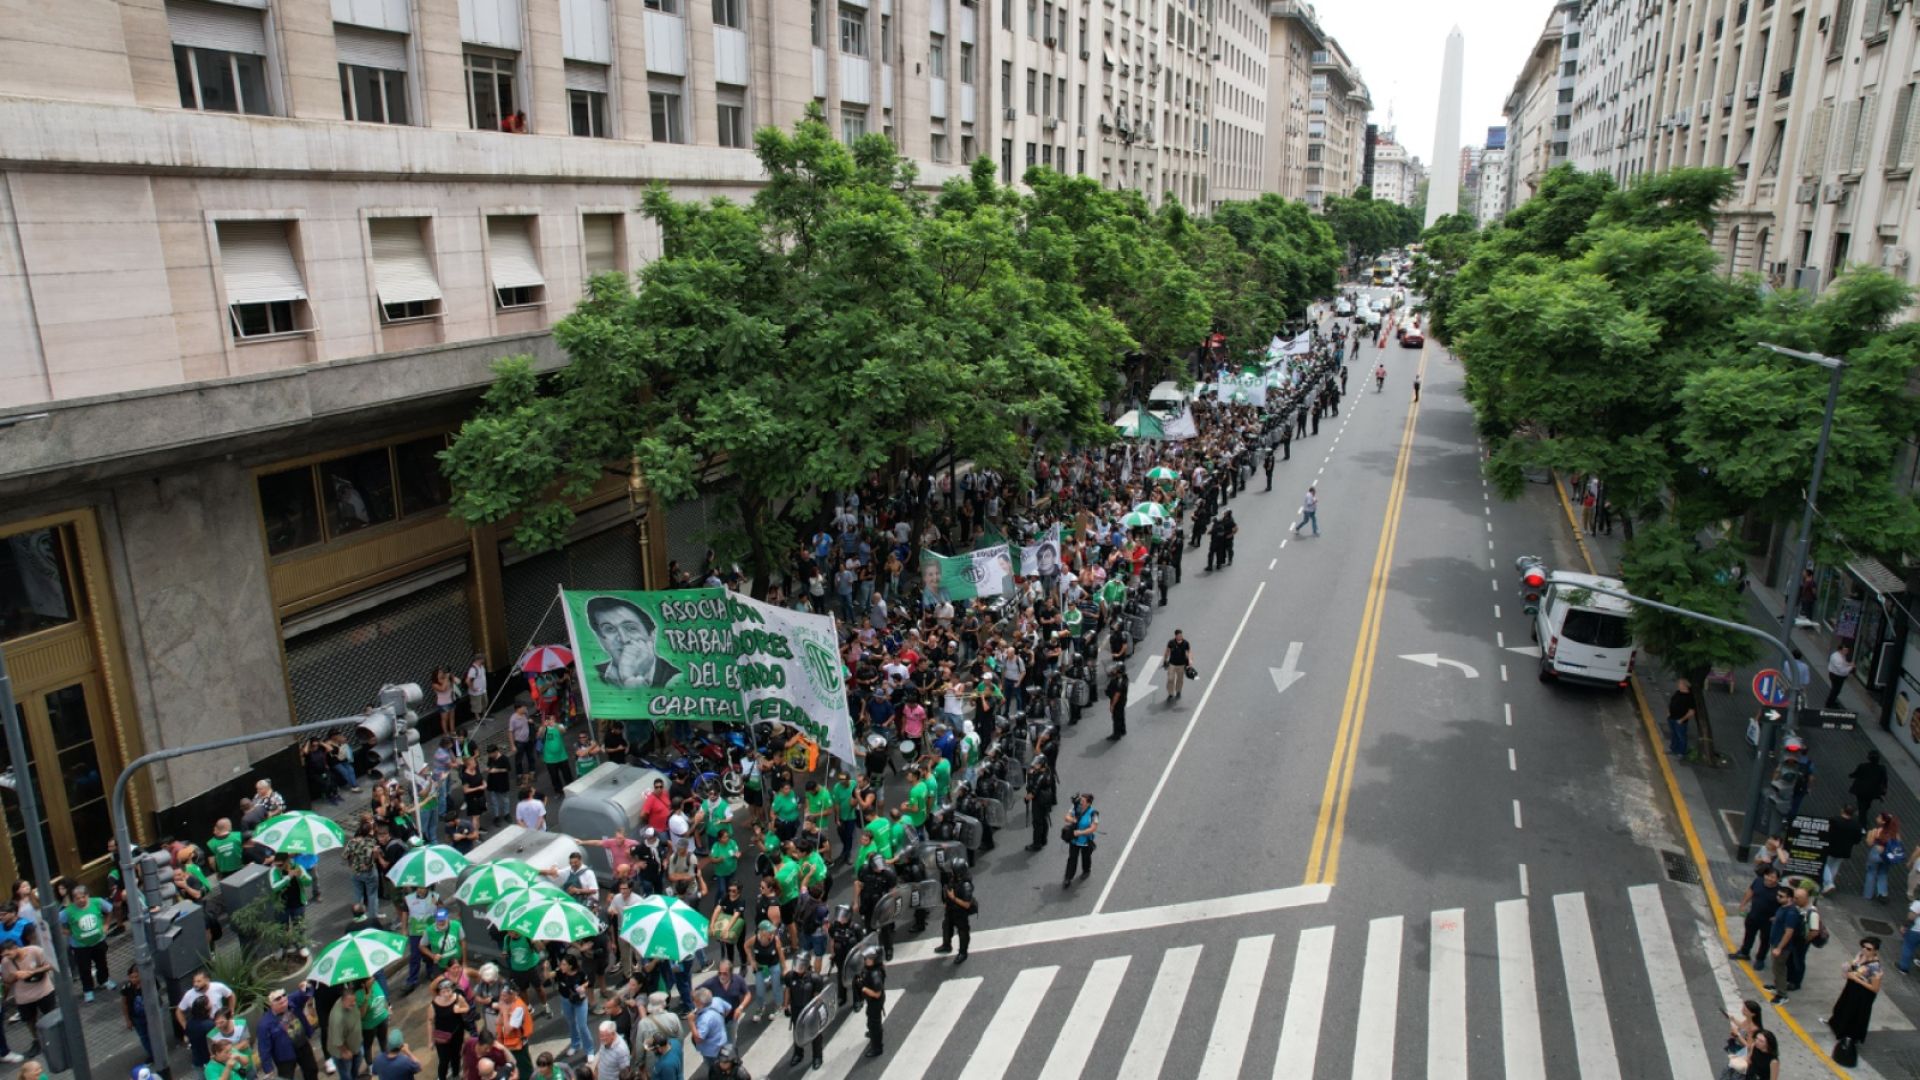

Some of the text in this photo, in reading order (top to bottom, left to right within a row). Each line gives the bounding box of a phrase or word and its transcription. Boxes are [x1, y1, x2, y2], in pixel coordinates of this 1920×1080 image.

[1222, 374, 1263, 387] SALUD
[688, 661, 720, 689] DEL
[649, 695, 831, 748] CAPITAL FEDAL
